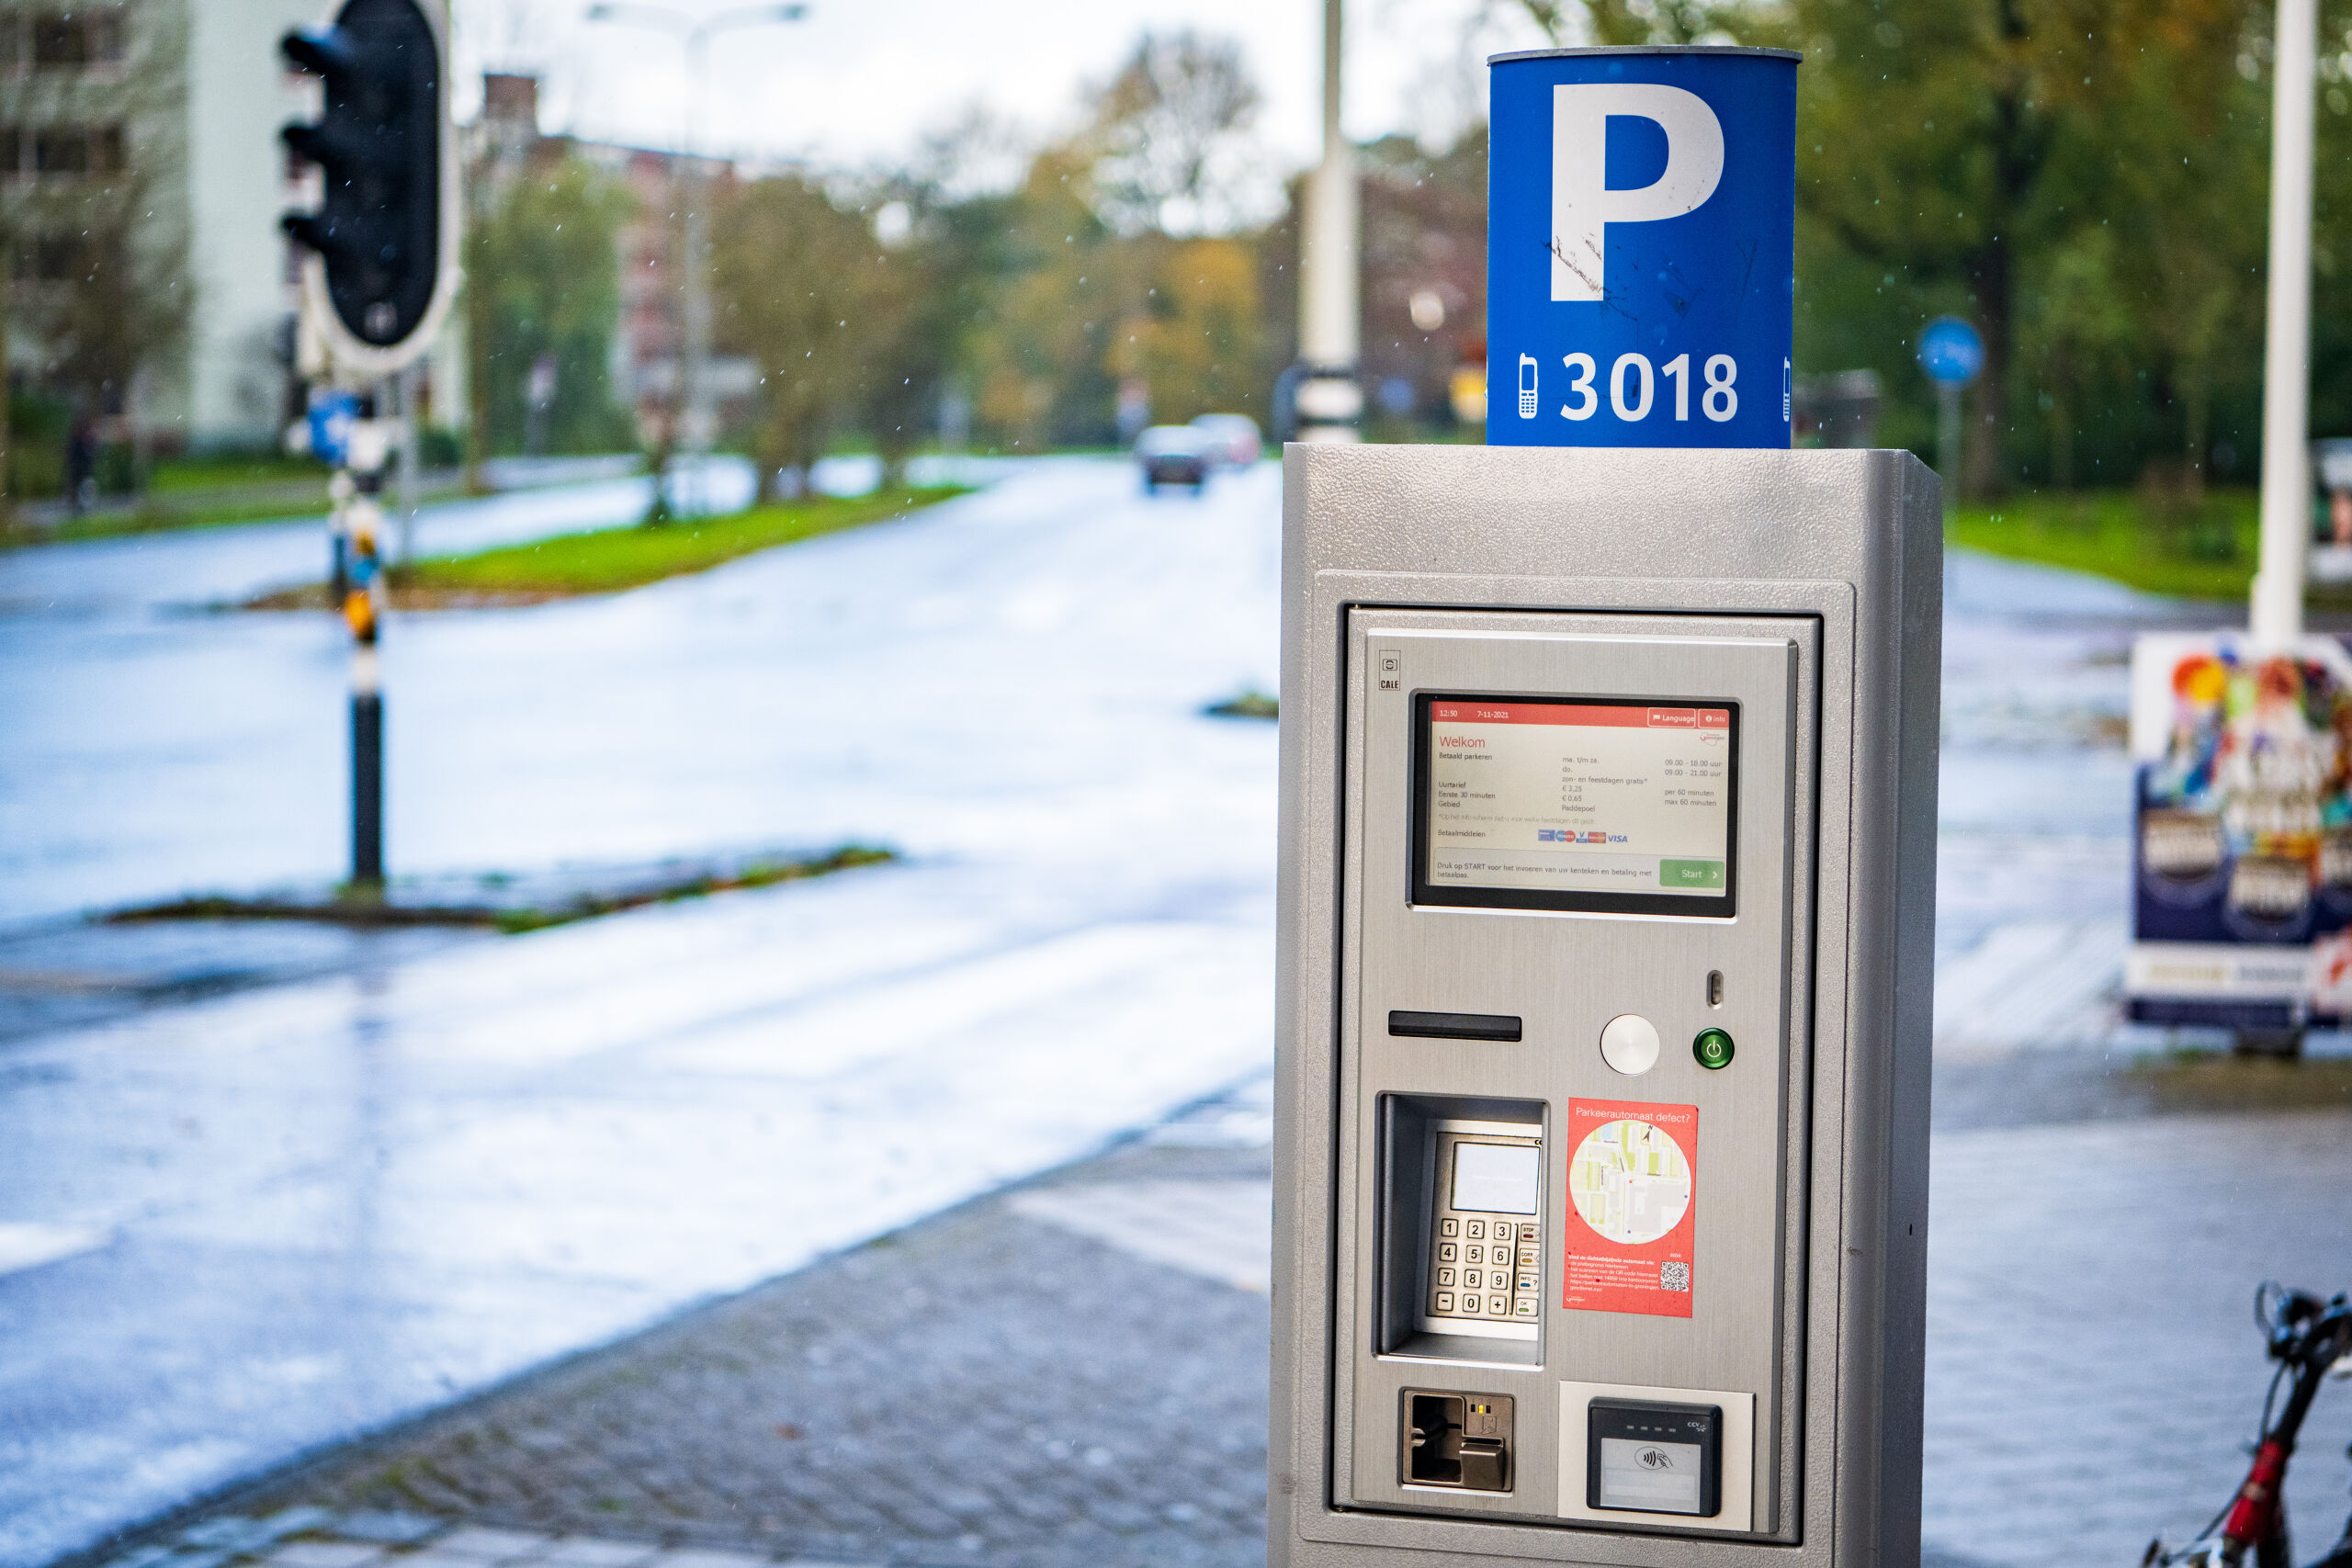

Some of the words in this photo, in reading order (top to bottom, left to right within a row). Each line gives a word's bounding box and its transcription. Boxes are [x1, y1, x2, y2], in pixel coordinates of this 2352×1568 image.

[1551, 83, 1724, 301] P
[1560, 352, 1738, 422] 3018
[1381, 681, 1398, 689] CALE
[1663, 715, 1694, 724] Language
[1440, 736, 1485, 748] Welkom
[1589, 776, 1623, 784] feestdagen
[1562, 805, 1595, 813] Paddepoel
[1438, 829, 1486, 838] Betaalmiddelen
[1611, 869, 1637, 877] betaling
[1682, 869, 1702, 878] Start
[1577, 1107, 1653, 1121] Parkeerautomaat
[1657, 1112, 1690, 1123] defect?
[1447, 1224, 1452, 1233] 1
[1473, 1225, 1478, 1235] 2
[1499, 1226, 1505, 1236] 3
[1444, 1248, 1451, 1258] 4
[1471, 1250, 1477, 1259] 5
[1498, 1251, 1503, 1261] 6
[1444, 1272, 1450, 1282] 7
[1469, 1274, 1476, 1283] 8
[1496, 1276, 1502, 1285] 9
[1468, 1298, 1474, 1308] 0
